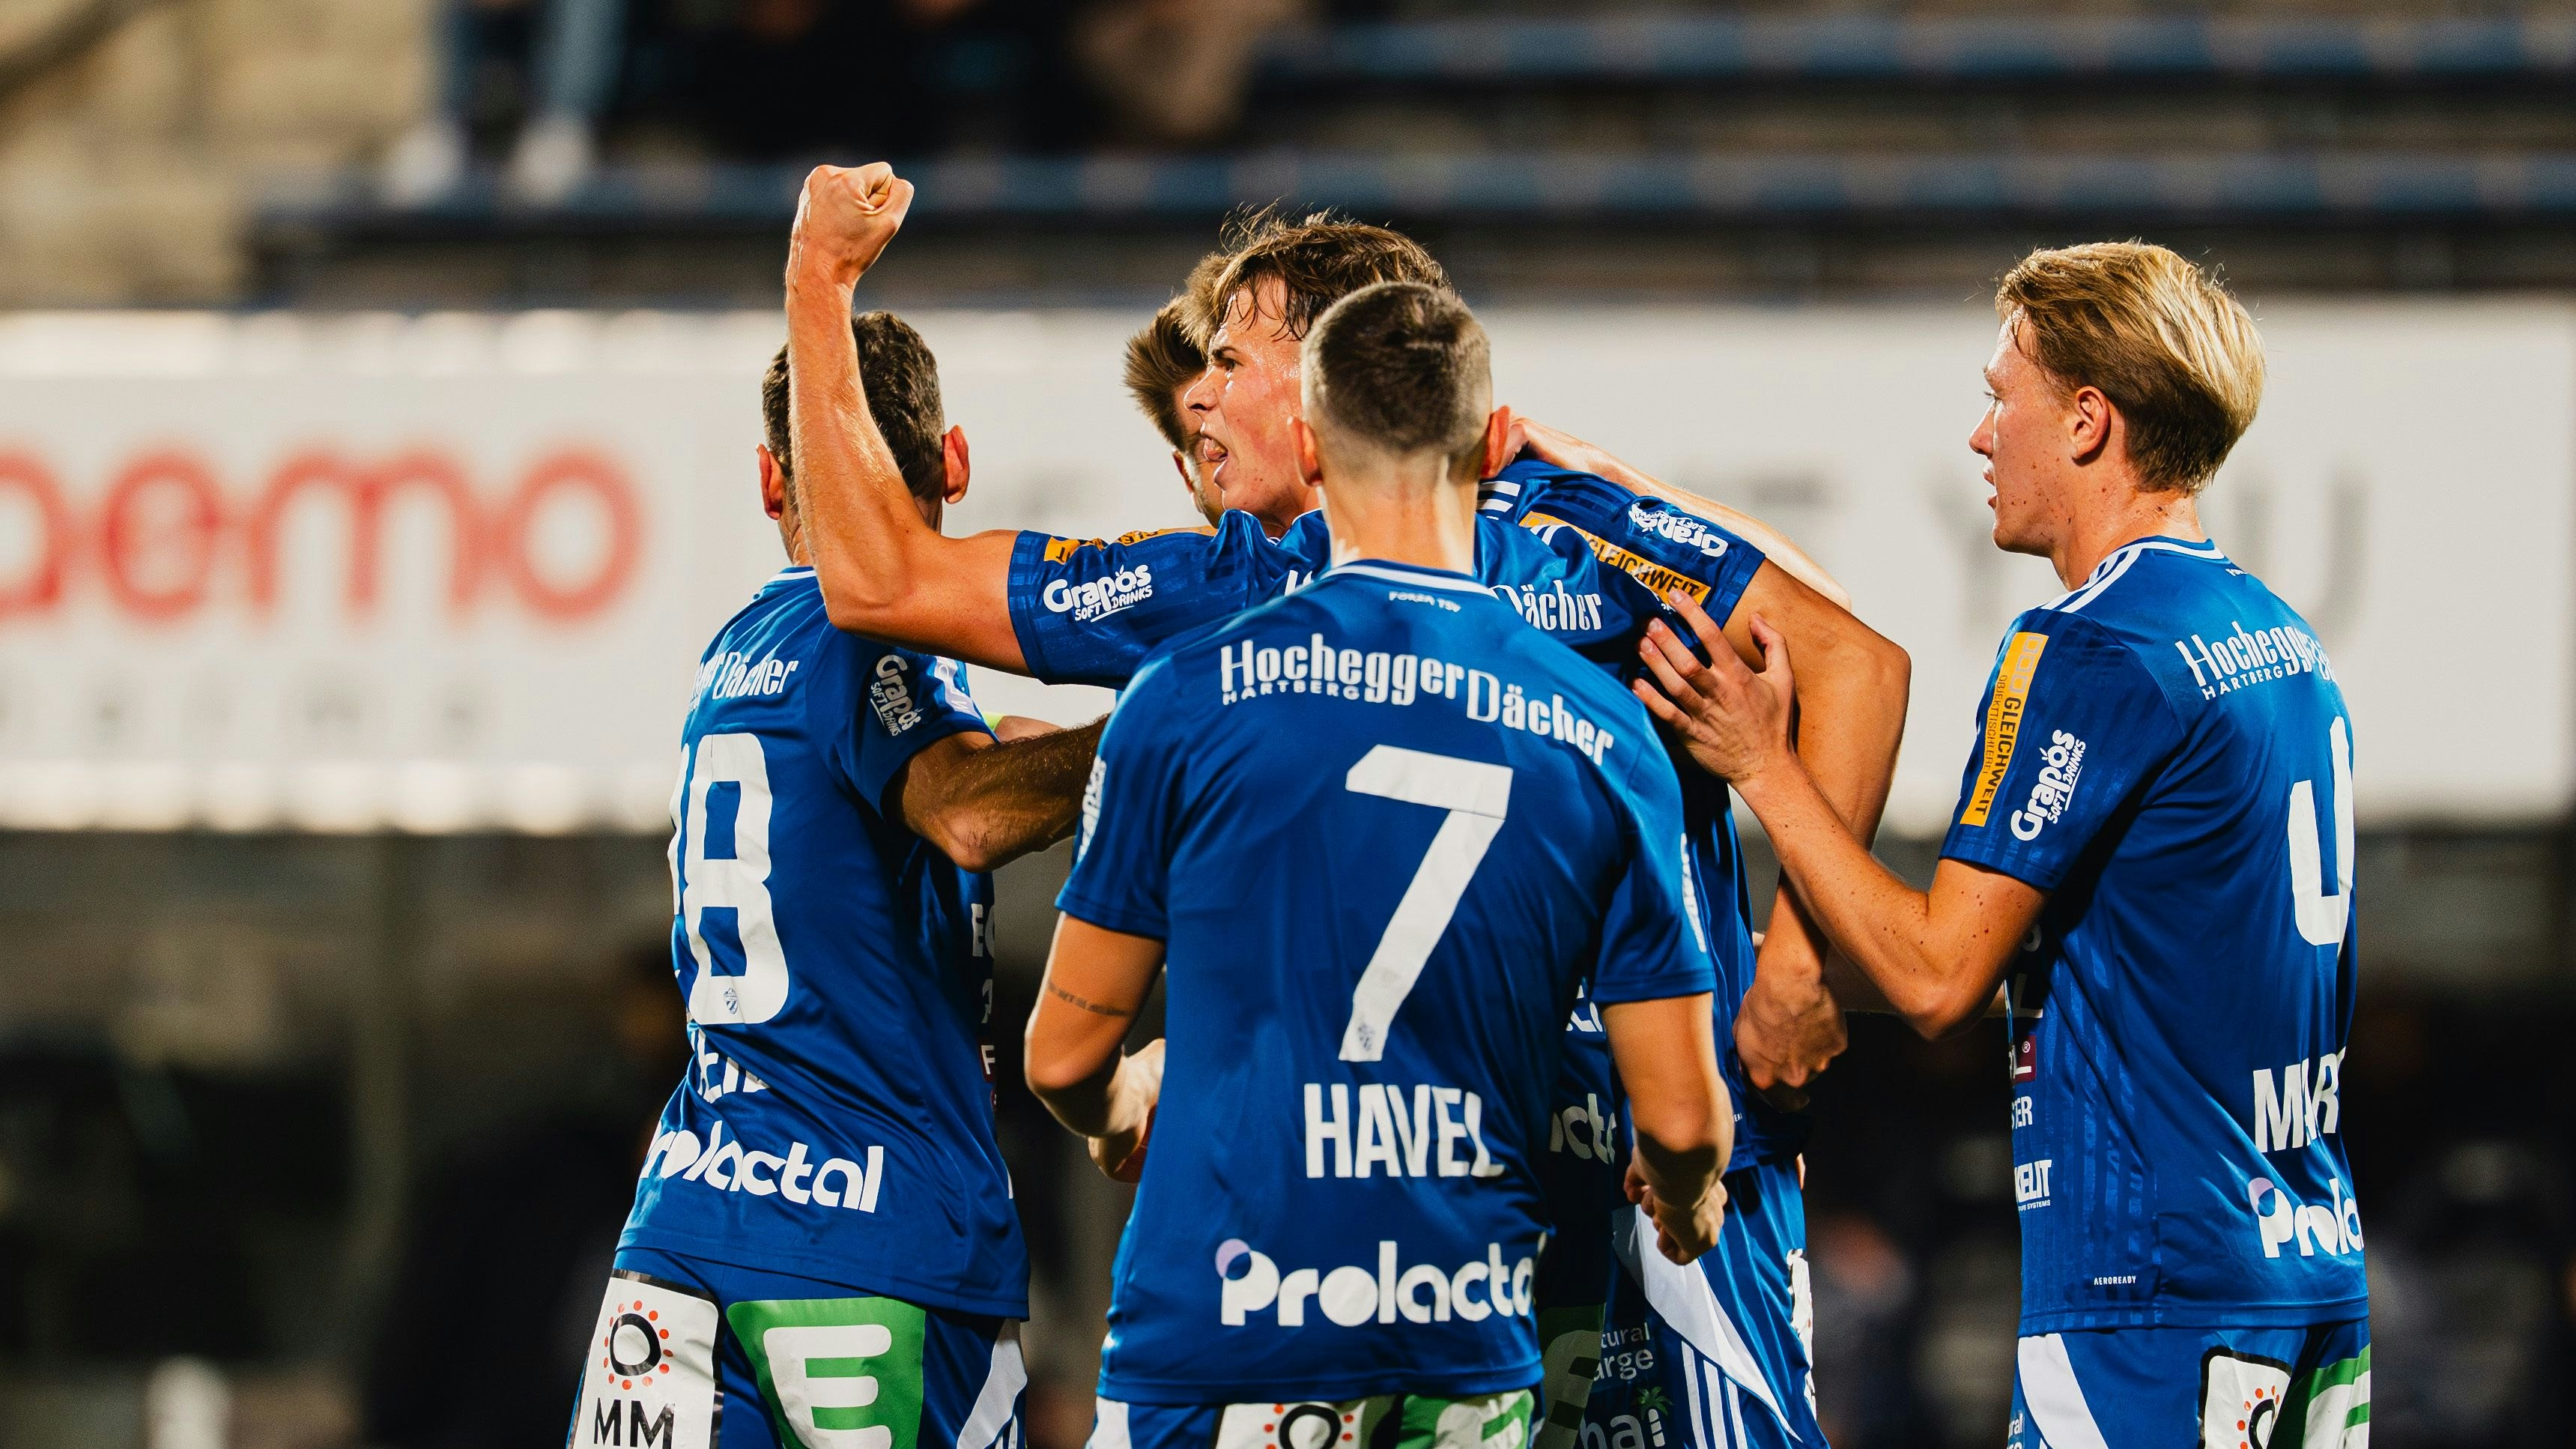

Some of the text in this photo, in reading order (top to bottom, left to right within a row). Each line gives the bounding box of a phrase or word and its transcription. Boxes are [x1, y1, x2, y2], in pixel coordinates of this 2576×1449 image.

[1075, 585, 1153, 621] SOFT DRINKS
[870, 682, 888, 704] SOFT
[1220, 633, 1614, 767] Hochegger Dächer
[1222, 679, 1360, 706] HARTBERG
[2201, 665, 2284, 701] HARTBERG
[1975, 697, 2022, 815] GLEICHWEIT
[2047, 739, 2086, 825] SOFT DRINKS
[1339, 743, 1513, 1062] 7
[1303, 1083, 1505, 1179] HAVEL
[2252, 1046, 2347, 1153] MAR
[640, 1119, 884, 1214] rolactal
[2248, 1177, 2365, 1258] Prola
[2094, 1275, 2136, 1286] AEROREADY
[1593, 1349, 1654, 1380] arge
[1600, 1322, 1650, 1349] tural
[594, 1397, 675, 1449] MM
